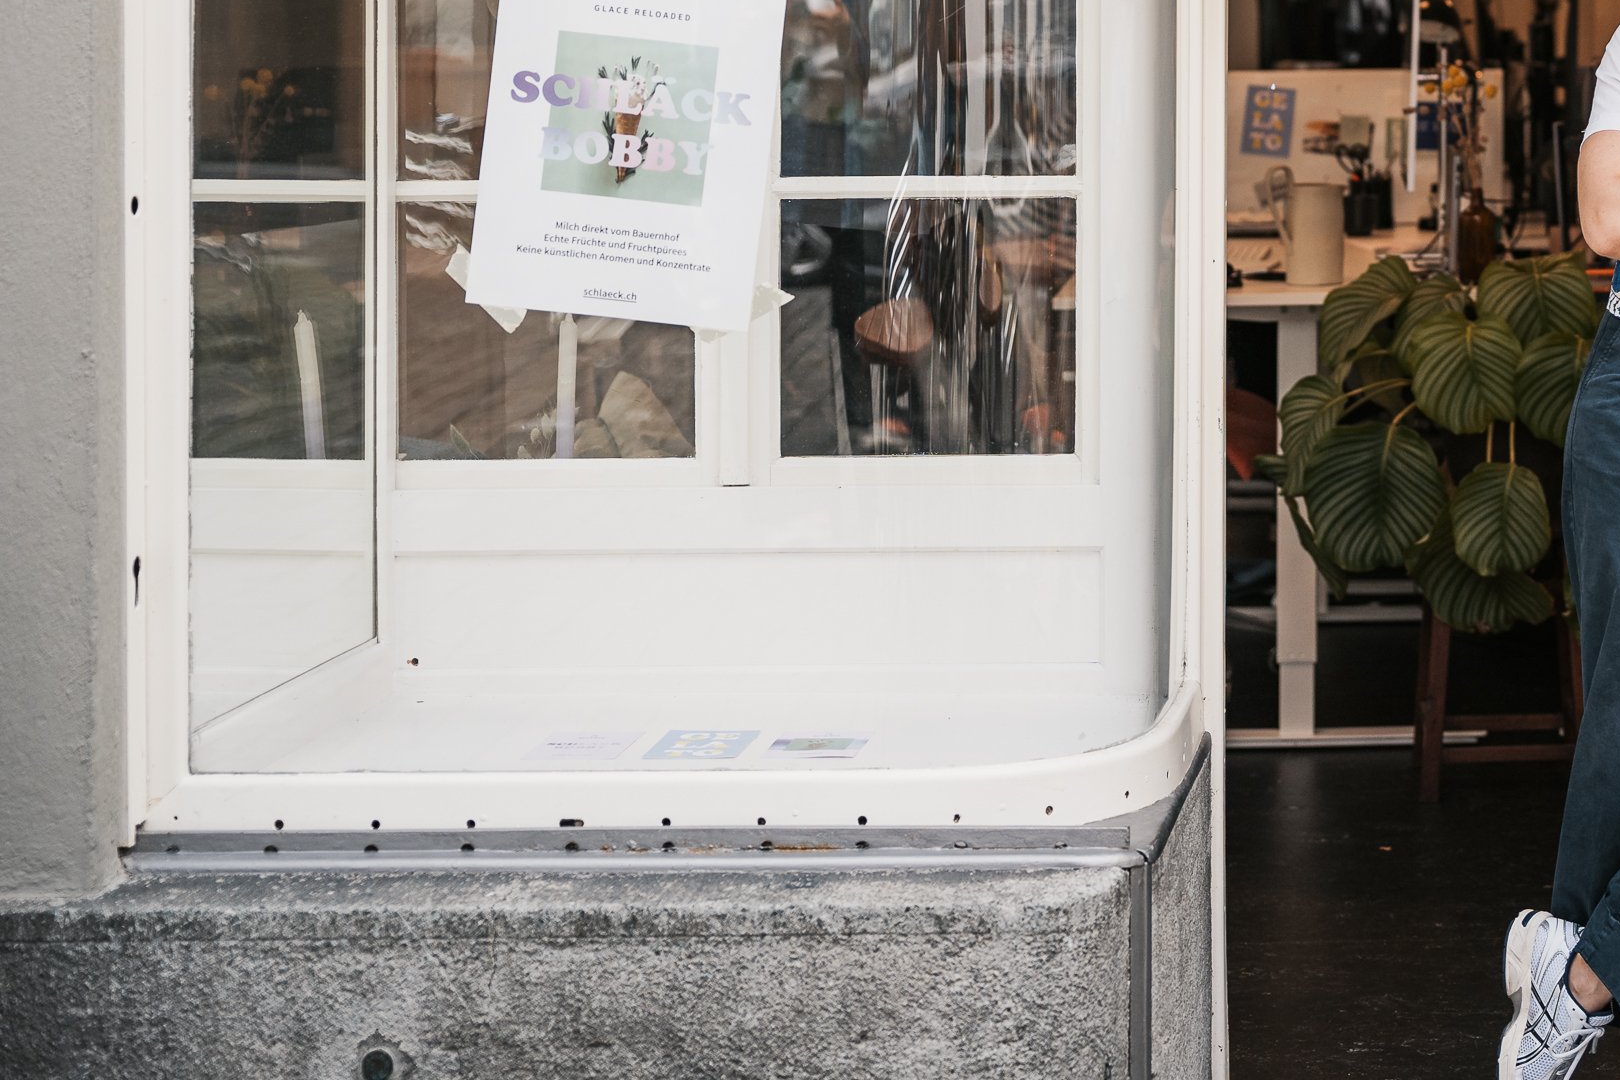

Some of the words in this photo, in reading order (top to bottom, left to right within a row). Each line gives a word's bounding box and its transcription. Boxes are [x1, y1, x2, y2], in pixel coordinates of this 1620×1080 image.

[594, 4, 629, 14] GLACE
[634, 8, 691, 21] RELOADED
[510, 70, 752, 126] SCHLÄCK
[540, 126, 714, 176] BOBBY
[555, 221, 580, 231] Milch
[581, 224, 608, 234] direkt
[610, 228, 630, 237] vom
[632, 229, 680, 242] Bauernhof
[544, 234, 570, 244] Echte
[571, 236, 606, 247] Früchte
[608, 241, 626, 249] und
[627, 242, 687, 256] Fruchtpürees
[516, 244, 542, 255] Keine
[544, 247, 597, 260] künstlichen
[599, 253, 635, 264] Aromen
[637, 258, 654, 266] und
[656, 259, 711, 272] Konzentrate
[583, 288, 637, 301] schlaeck.ch
